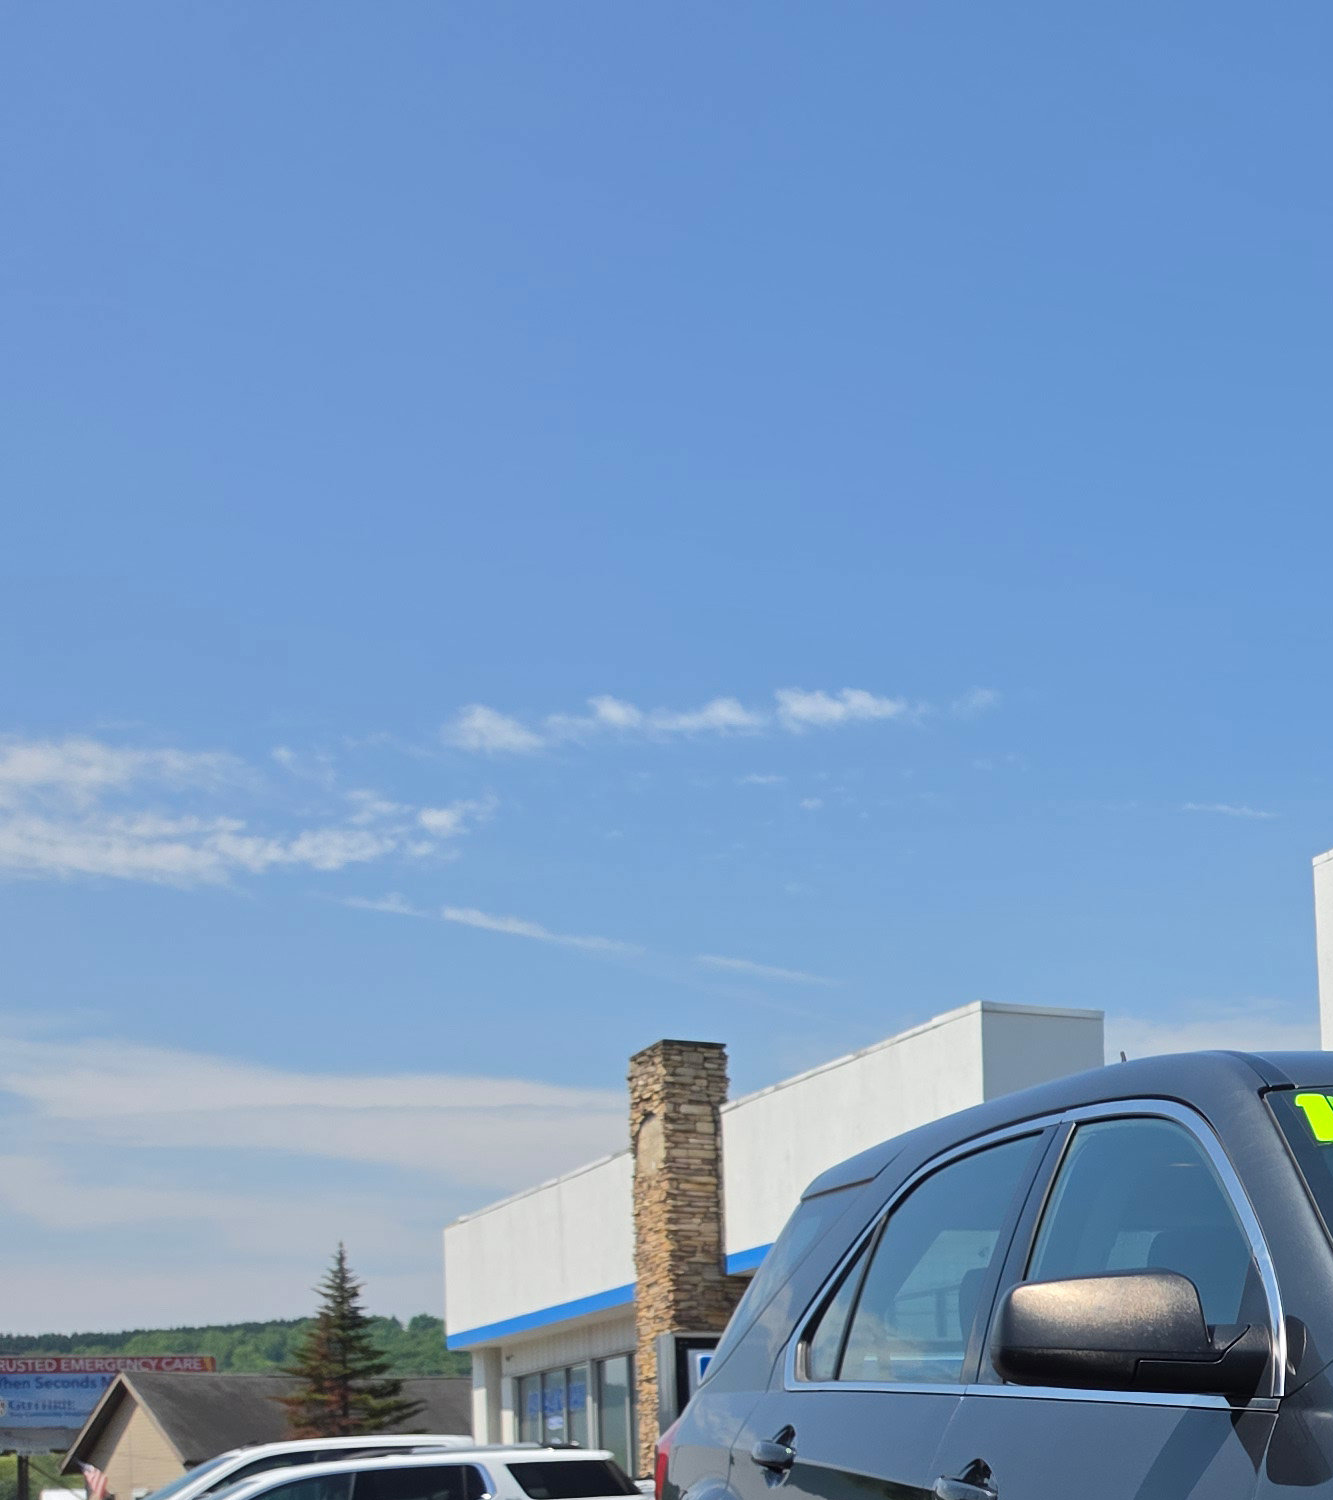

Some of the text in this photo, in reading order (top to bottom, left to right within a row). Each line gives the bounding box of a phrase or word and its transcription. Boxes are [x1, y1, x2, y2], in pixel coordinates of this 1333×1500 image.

[61, 1358, 158, 1373] EMERGENCY
[161, 1358, 202, 1371] CARE
[35, 1376, 98, 1389] Seconds
